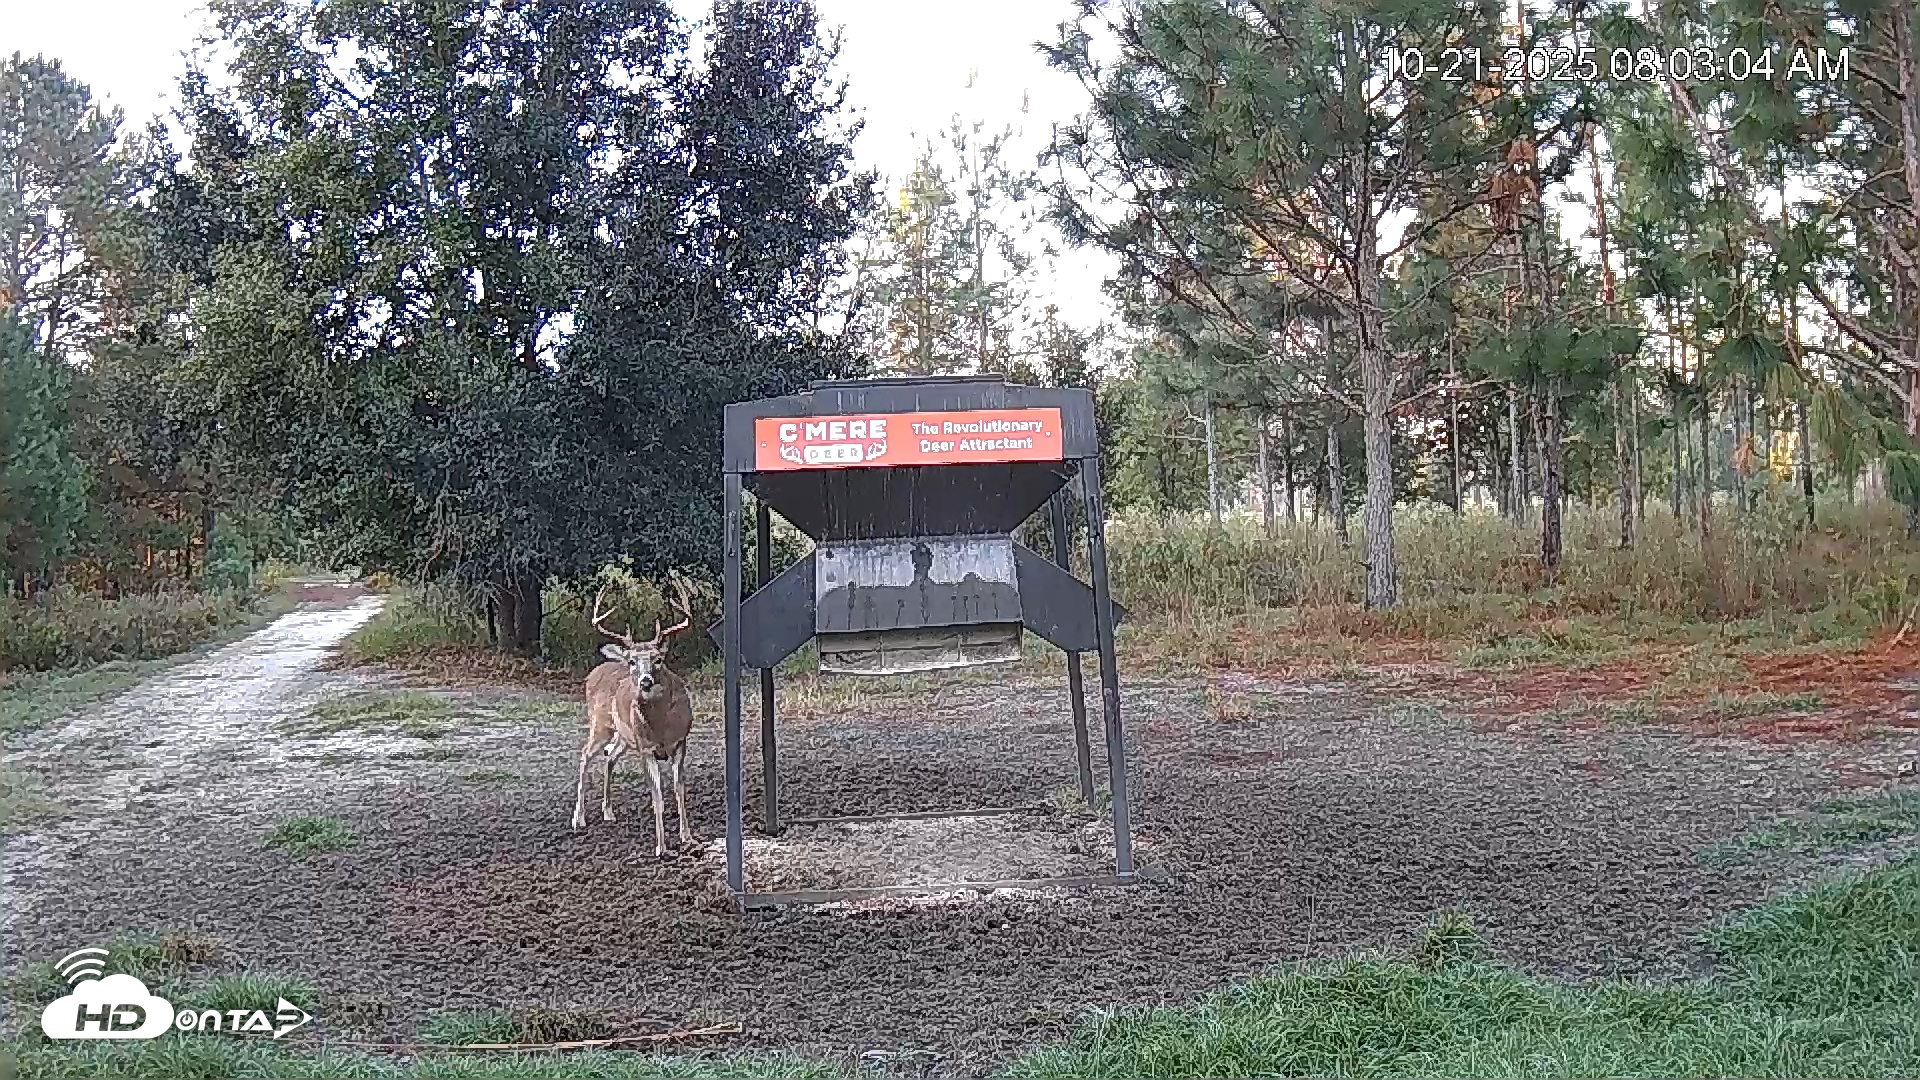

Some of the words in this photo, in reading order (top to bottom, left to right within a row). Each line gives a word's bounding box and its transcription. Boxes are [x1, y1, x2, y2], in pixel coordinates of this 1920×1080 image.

[780, 419, 887, 442] C'MERE
[911, 421, 939, 435] The
[943, 419, 1043, 434] Revolutionary
[809, 447, 859, 459] DEER
[920, 439, 955, 453] Deer
[959, 437, 1033, 451] Attractant
